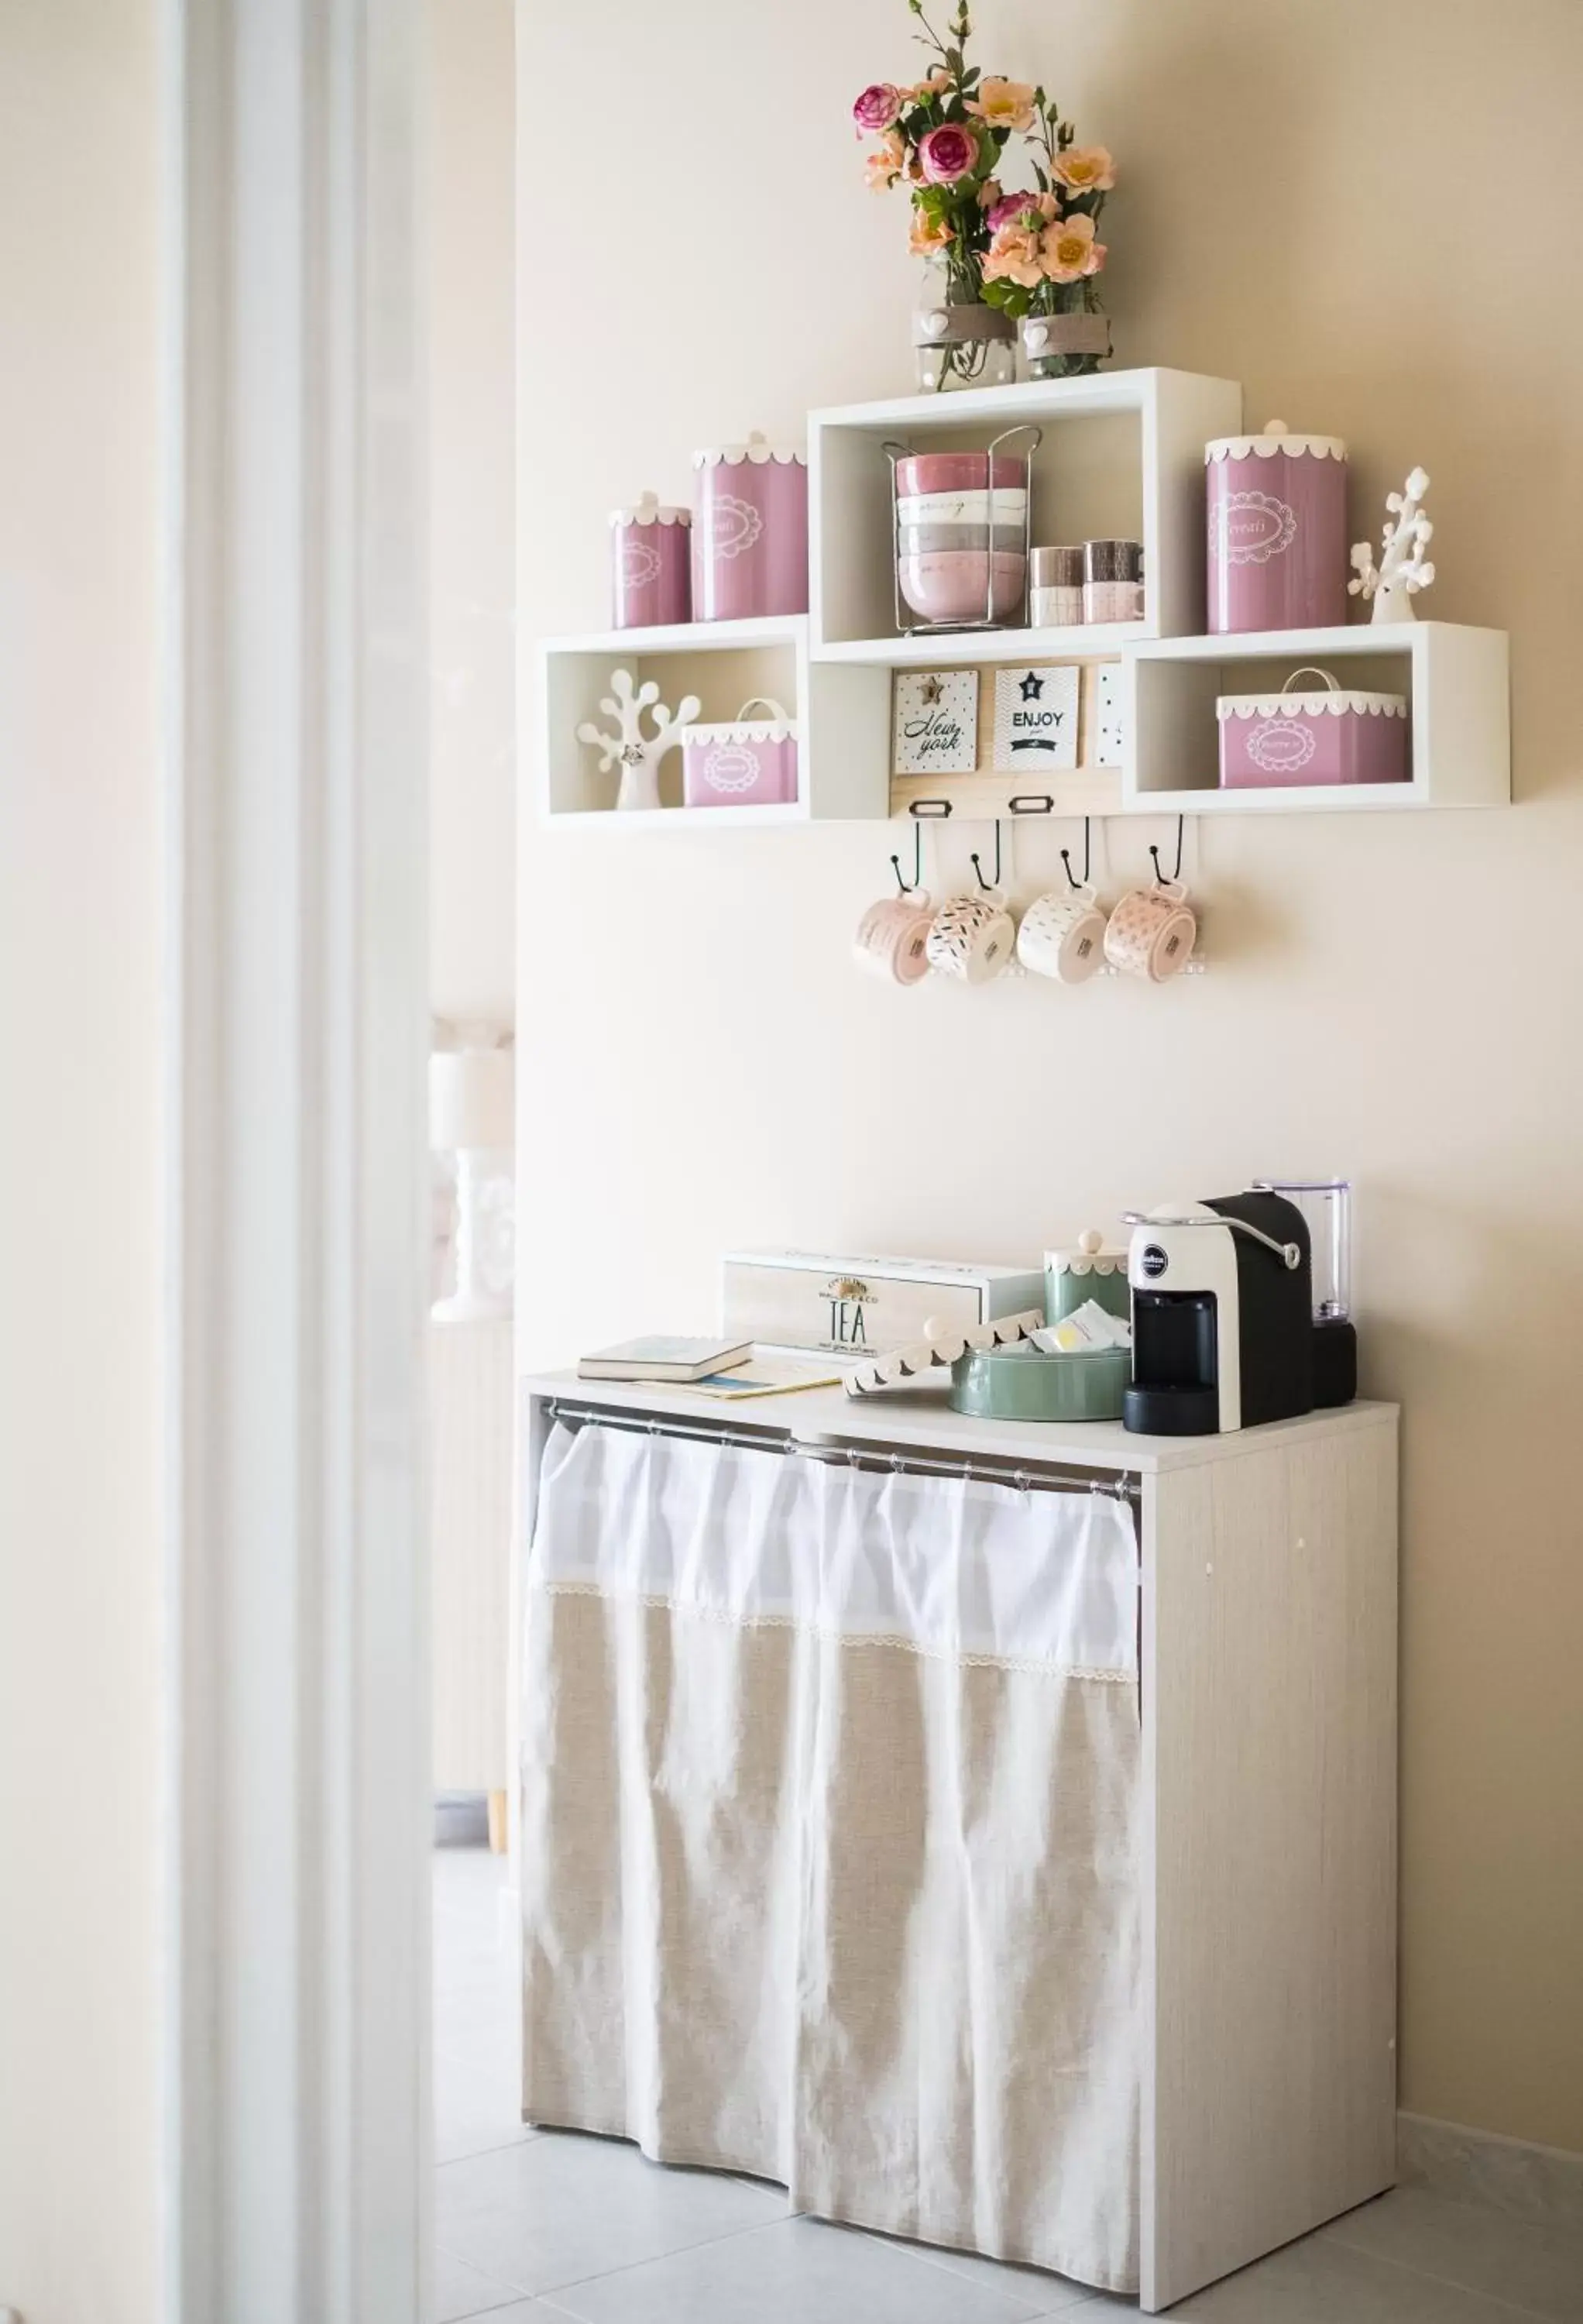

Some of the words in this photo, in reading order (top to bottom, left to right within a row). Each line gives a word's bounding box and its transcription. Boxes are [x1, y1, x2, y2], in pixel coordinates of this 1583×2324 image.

[904, 712, 957, 737] New
[1012, 711, 1064, 727] ENJOY
[916, 727, 961, 760] york
[830, 1301, 867, 1344] TEA
